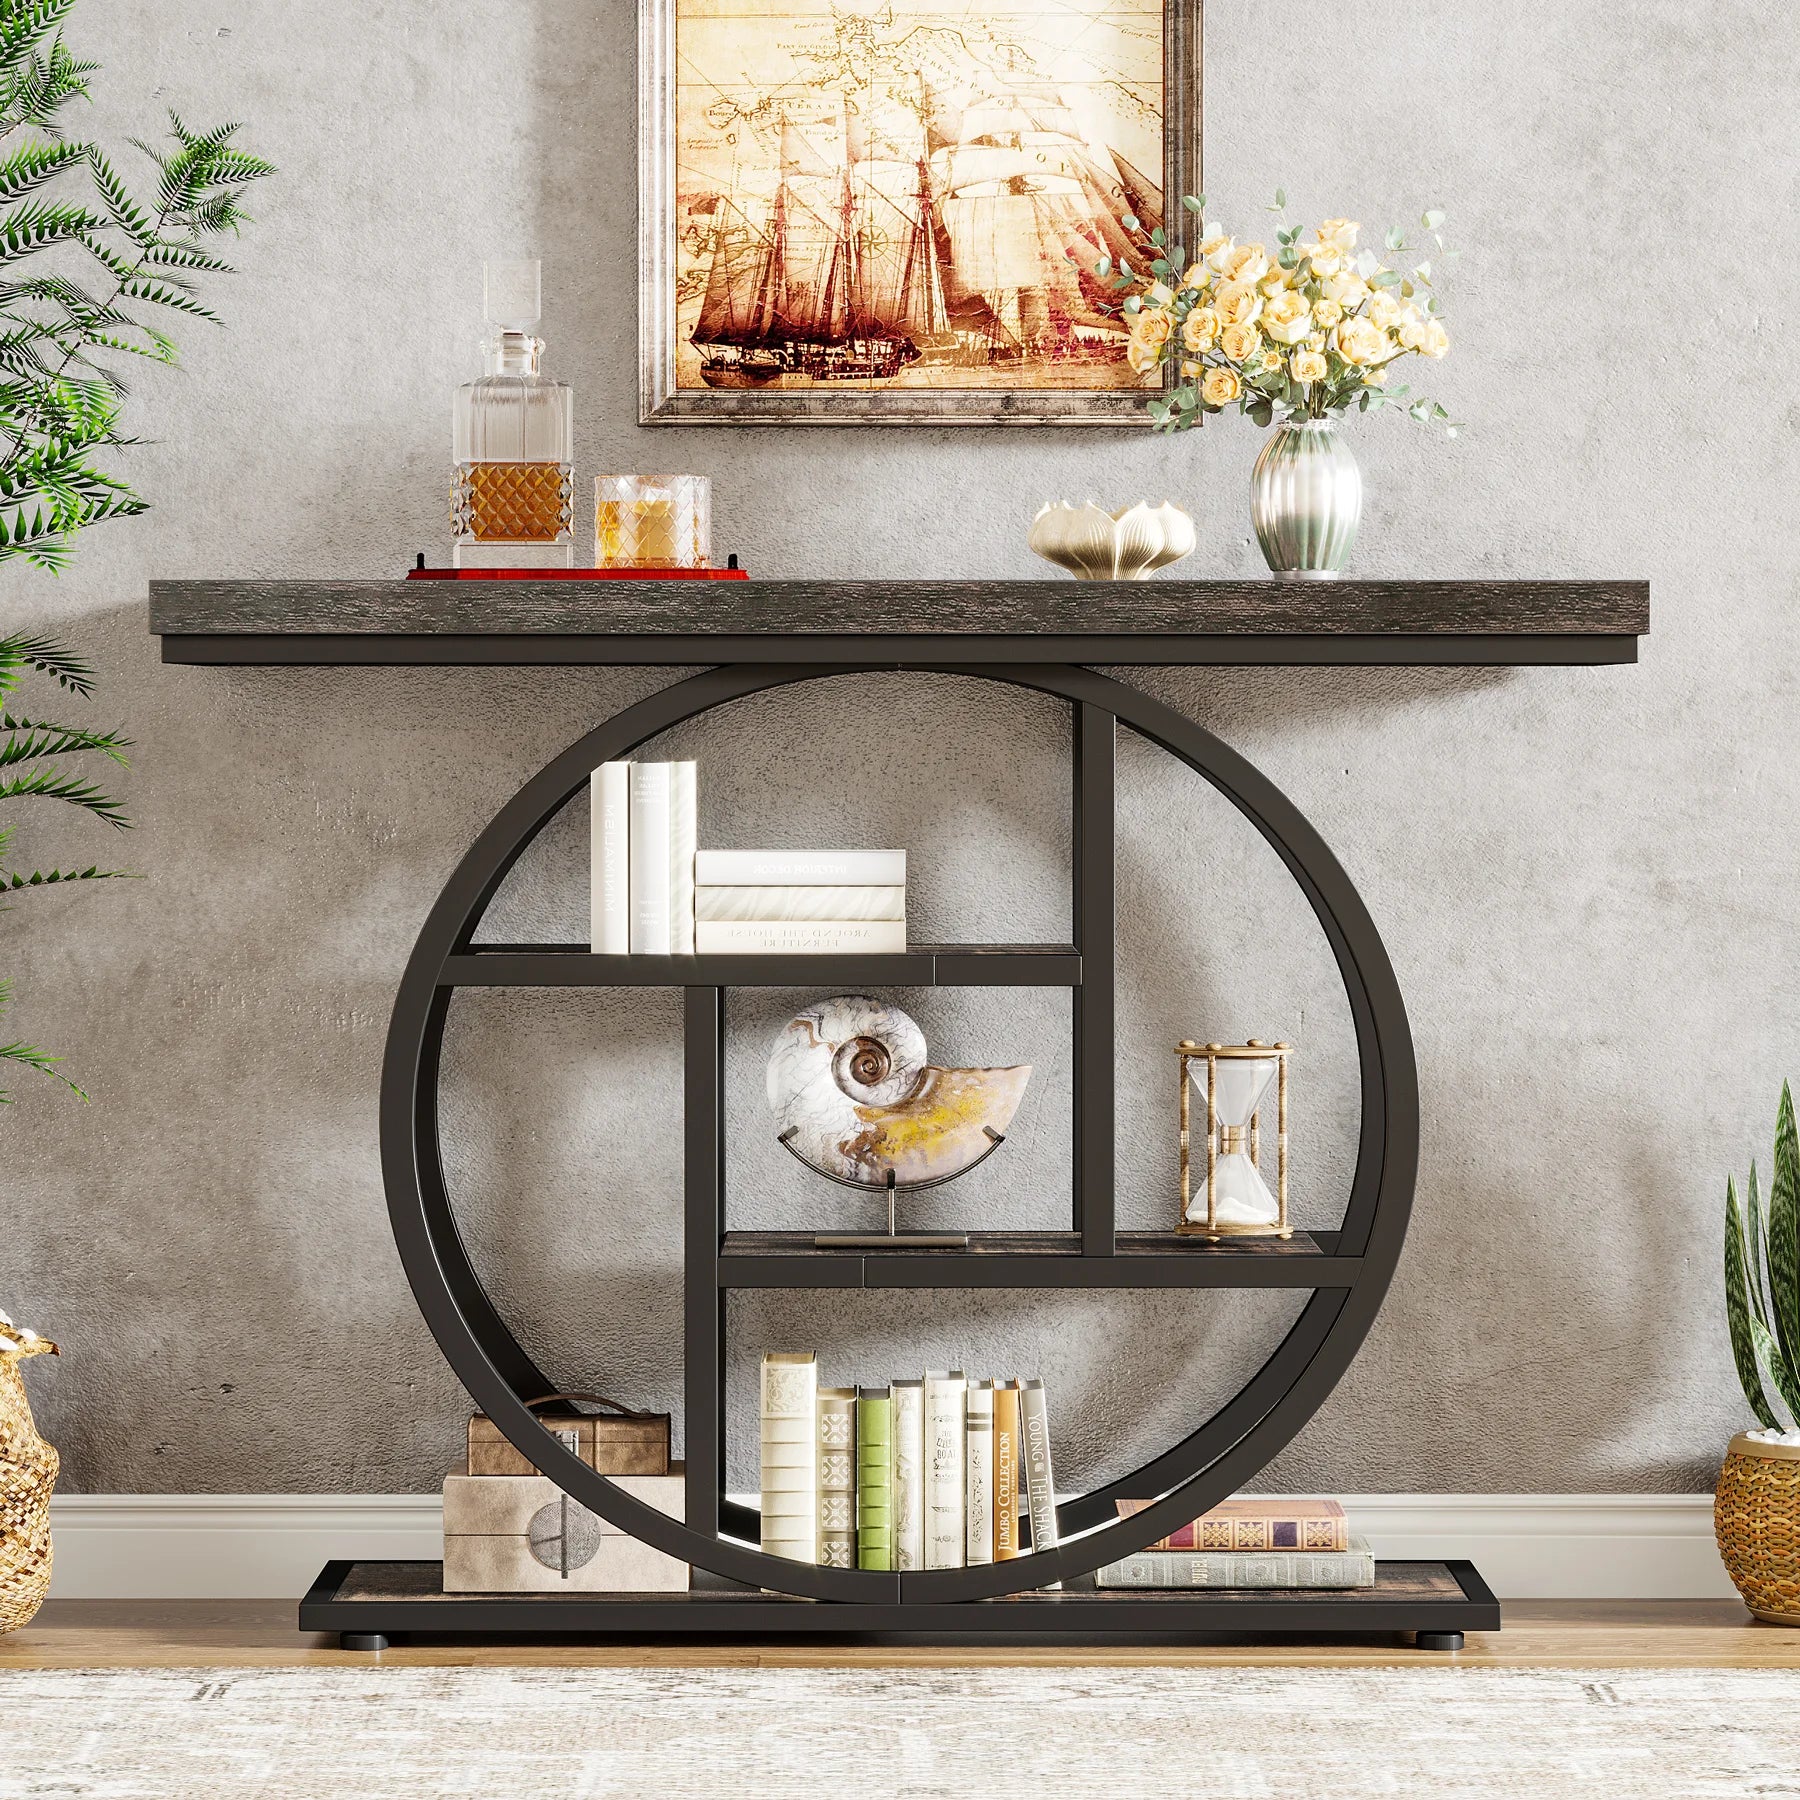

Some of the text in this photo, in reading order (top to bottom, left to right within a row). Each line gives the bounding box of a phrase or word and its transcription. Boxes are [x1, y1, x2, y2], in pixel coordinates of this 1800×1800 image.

[998, 1431, 1014, 1552] JUMBO COLLECTION
[1027, 1414, 1053, 1550] YOUNG THE SHACK
